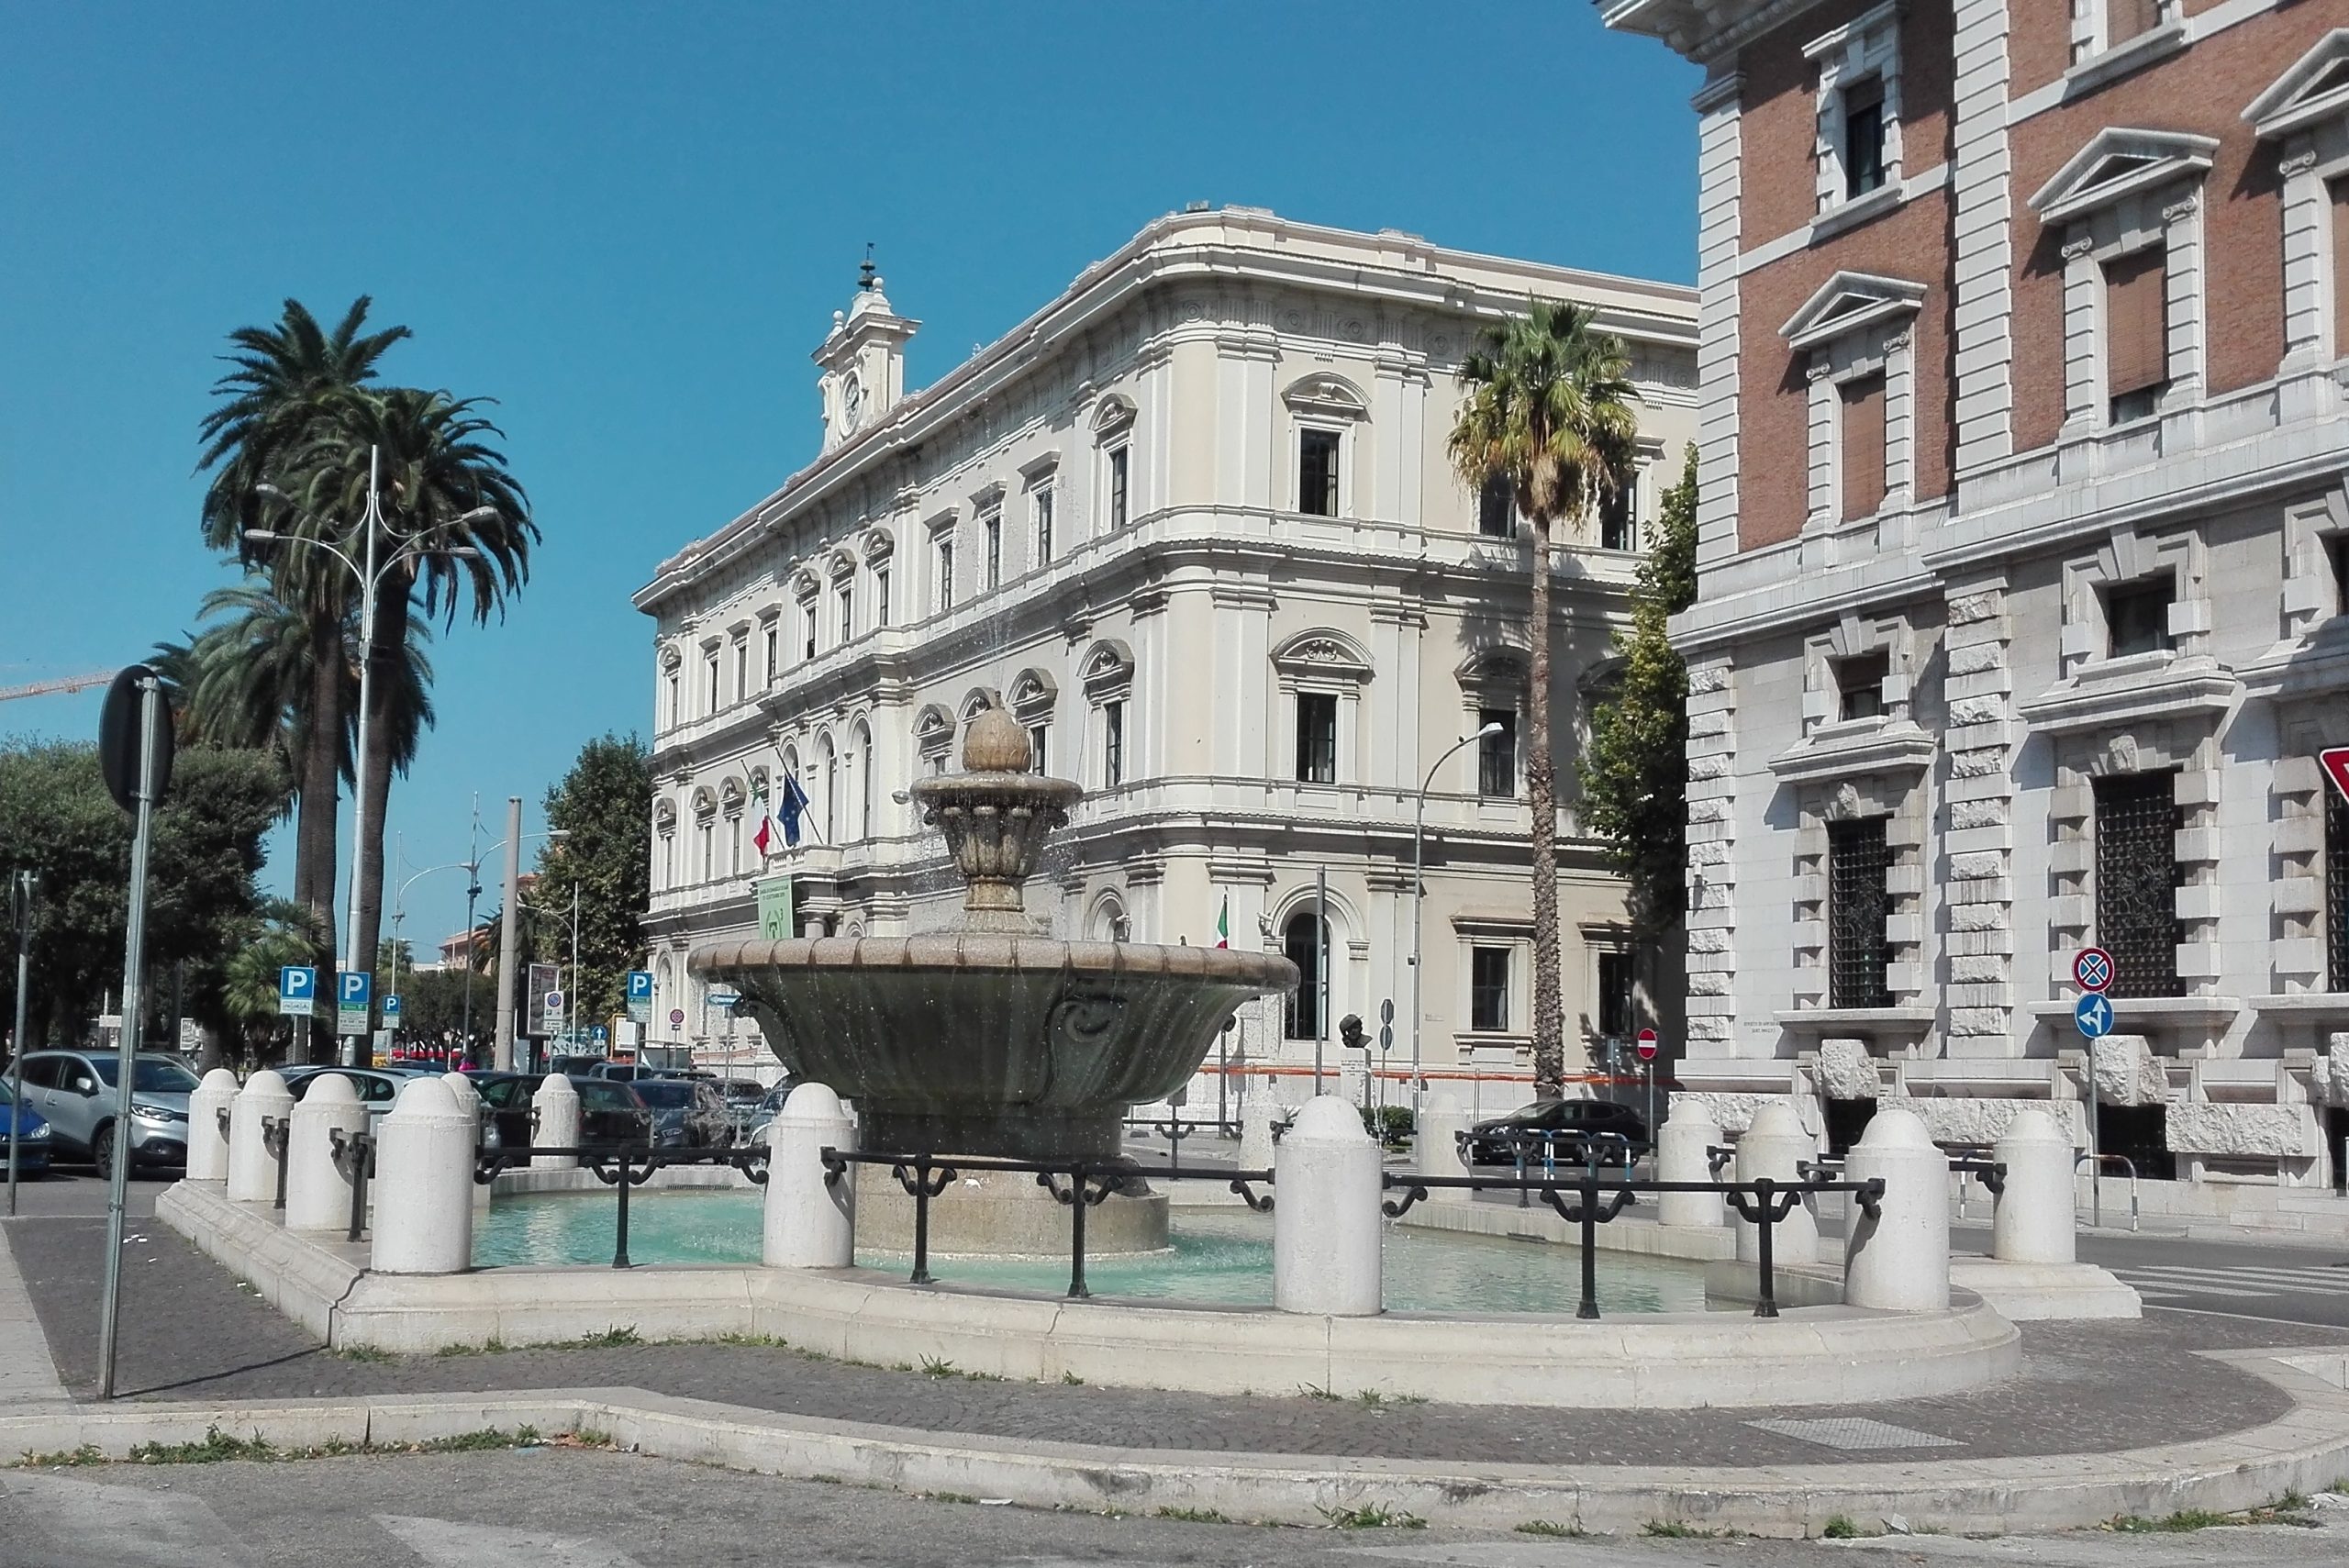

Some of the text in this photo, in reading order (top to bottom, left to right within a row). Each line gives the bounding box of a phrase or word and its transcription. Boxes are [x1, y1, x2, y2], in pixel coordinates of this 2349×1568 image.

[287, 971, 307, 995] P
[344, 975, 363, 999] P
[633, 975, 647, 994] P
[386, 997, 396, 1009] P
